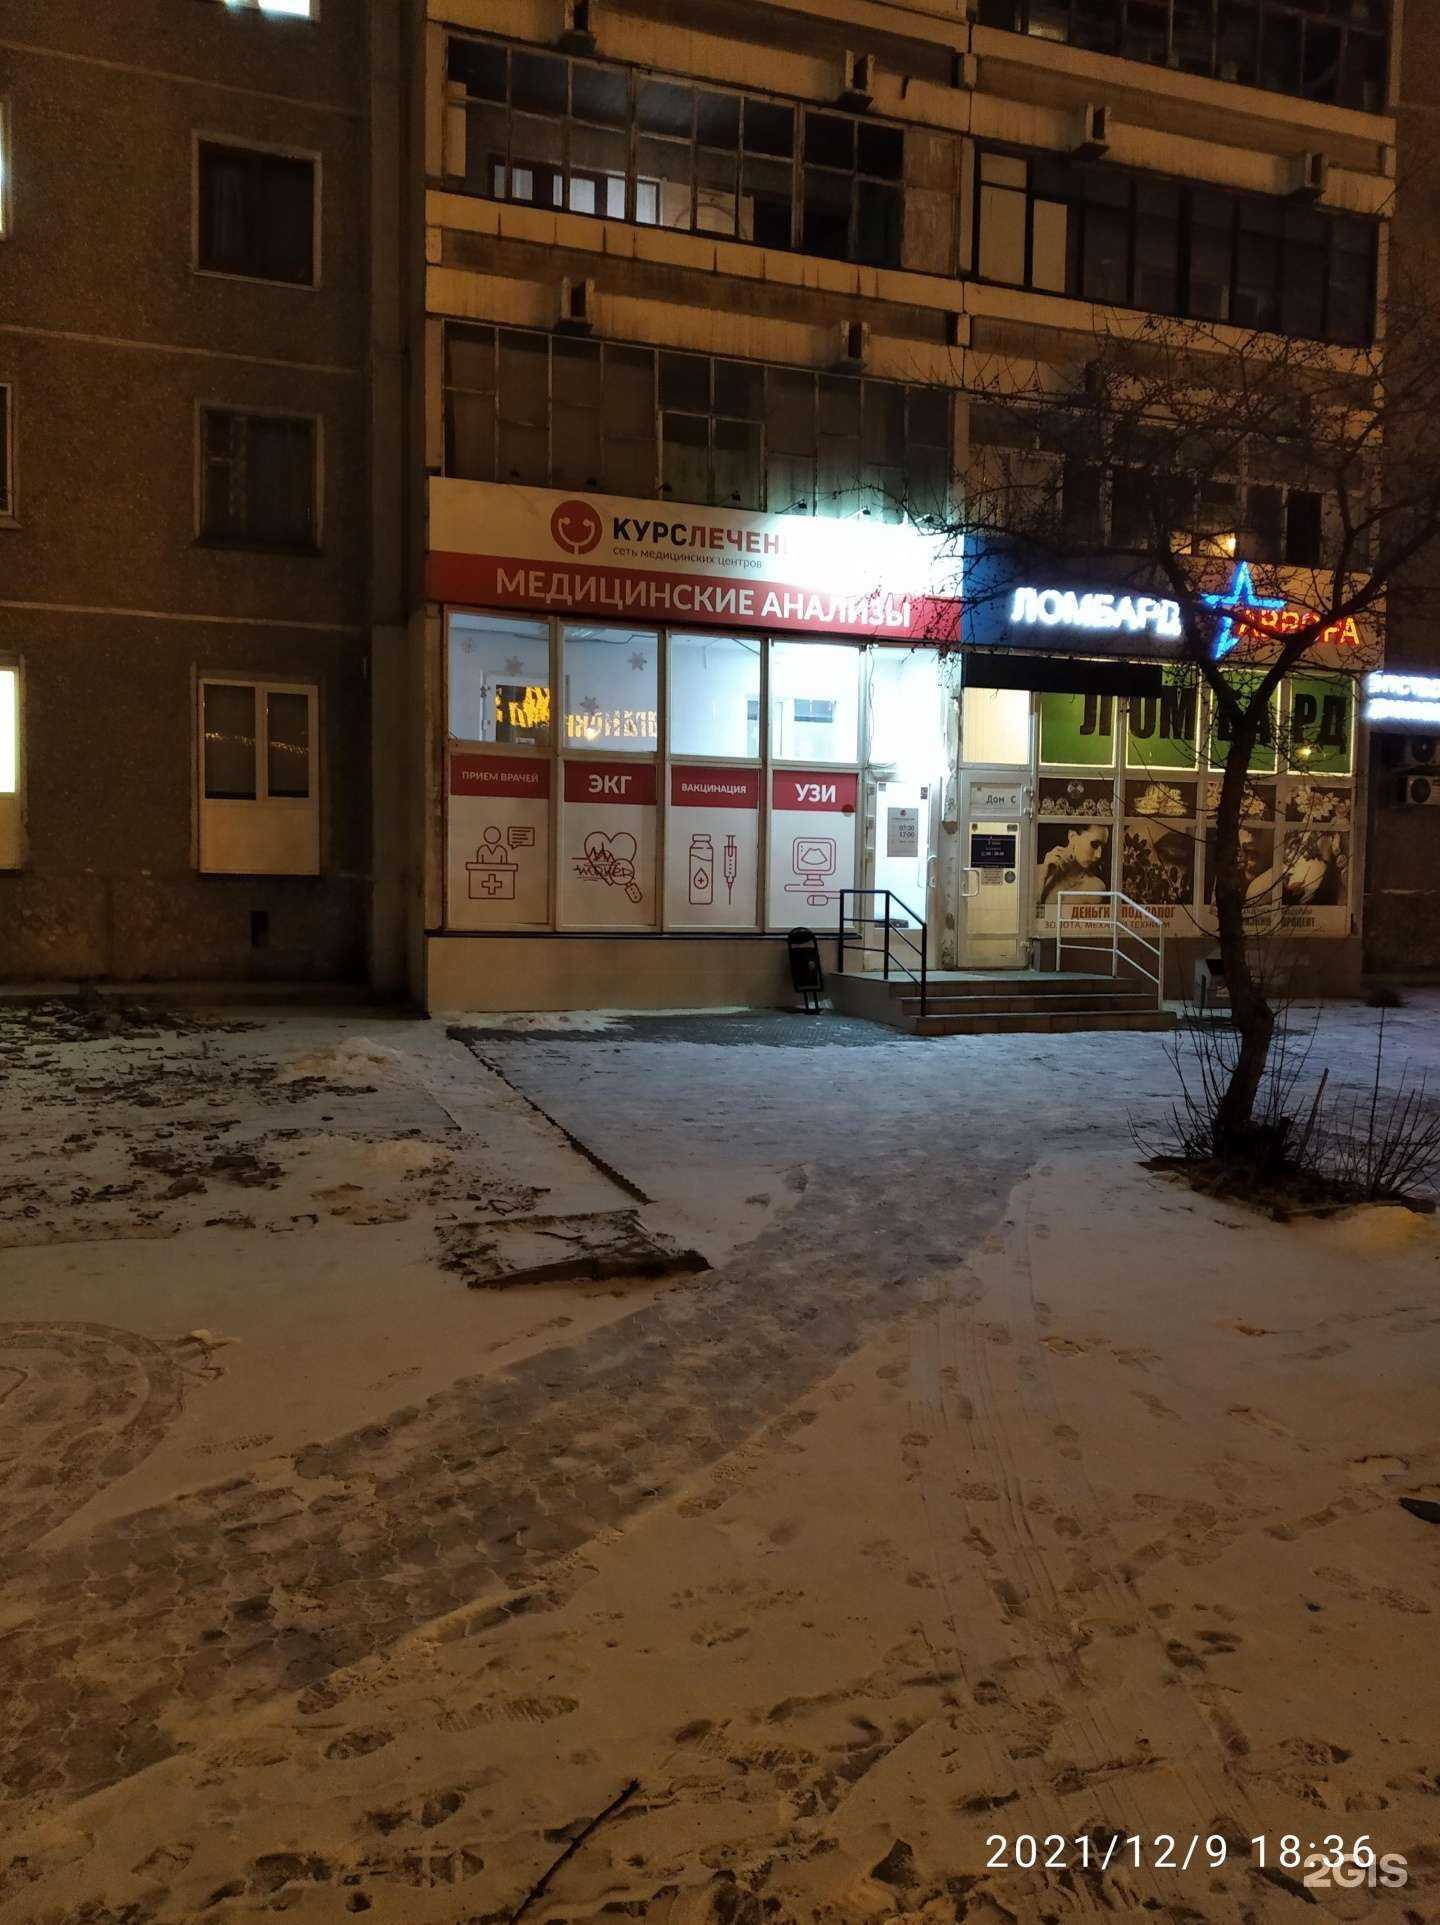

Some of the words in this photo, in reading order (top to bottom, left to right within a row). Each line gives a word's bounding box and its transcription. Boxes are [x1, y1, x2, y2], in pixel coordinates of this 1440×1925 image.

[613, 547, 637, 558] сеть
[641, 550, 714, 565] медицинских
[718, 557, 763, 570] центров
[495, 567, 753, 617] МЕДИЦИНСКИЕ
[760, 591, 910, 628] АНАЛИЗЫ
[1012, 588, 1182, 636] ЛОМБАРД
[462, 770, 498, 782] ПРИЕМ
[500, 772, 539, 784] ВРАЧЕЙ
[588, 774, 632, 795] ЭКГ
[681, 783, 746, 795] ВАКЦИНАЦИЯ
[795, 783, 837, 803] УЗИ
[986, 795, 1004, 804] Дом
[1071, 906, 1111, 920] ДЕНЬГИ
